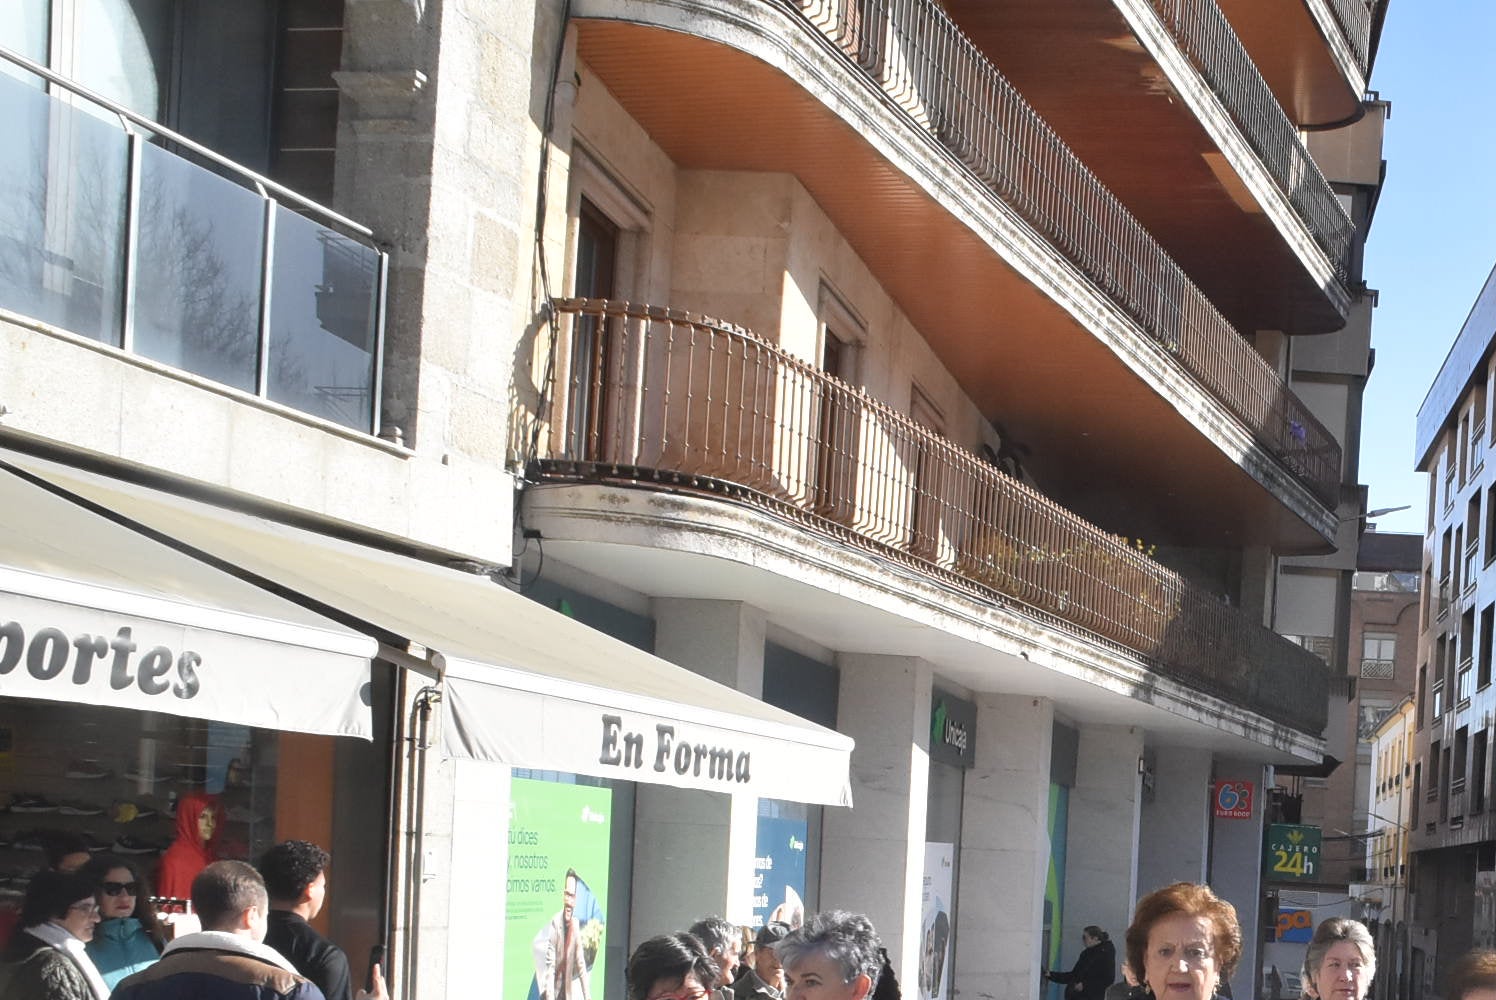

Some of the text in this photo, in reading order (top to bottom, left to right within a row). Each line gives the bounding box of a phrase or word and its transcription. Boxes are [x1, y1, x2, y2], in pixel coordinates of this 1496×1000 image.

[599, 713, 750, 783] En Forma
[517, 827, 539, 845] dices
[1271, 843, 1318, 854] CAJERO
[513, 852, 549, 869] nosotros
[1273, 850, 1313, 877] 24h
